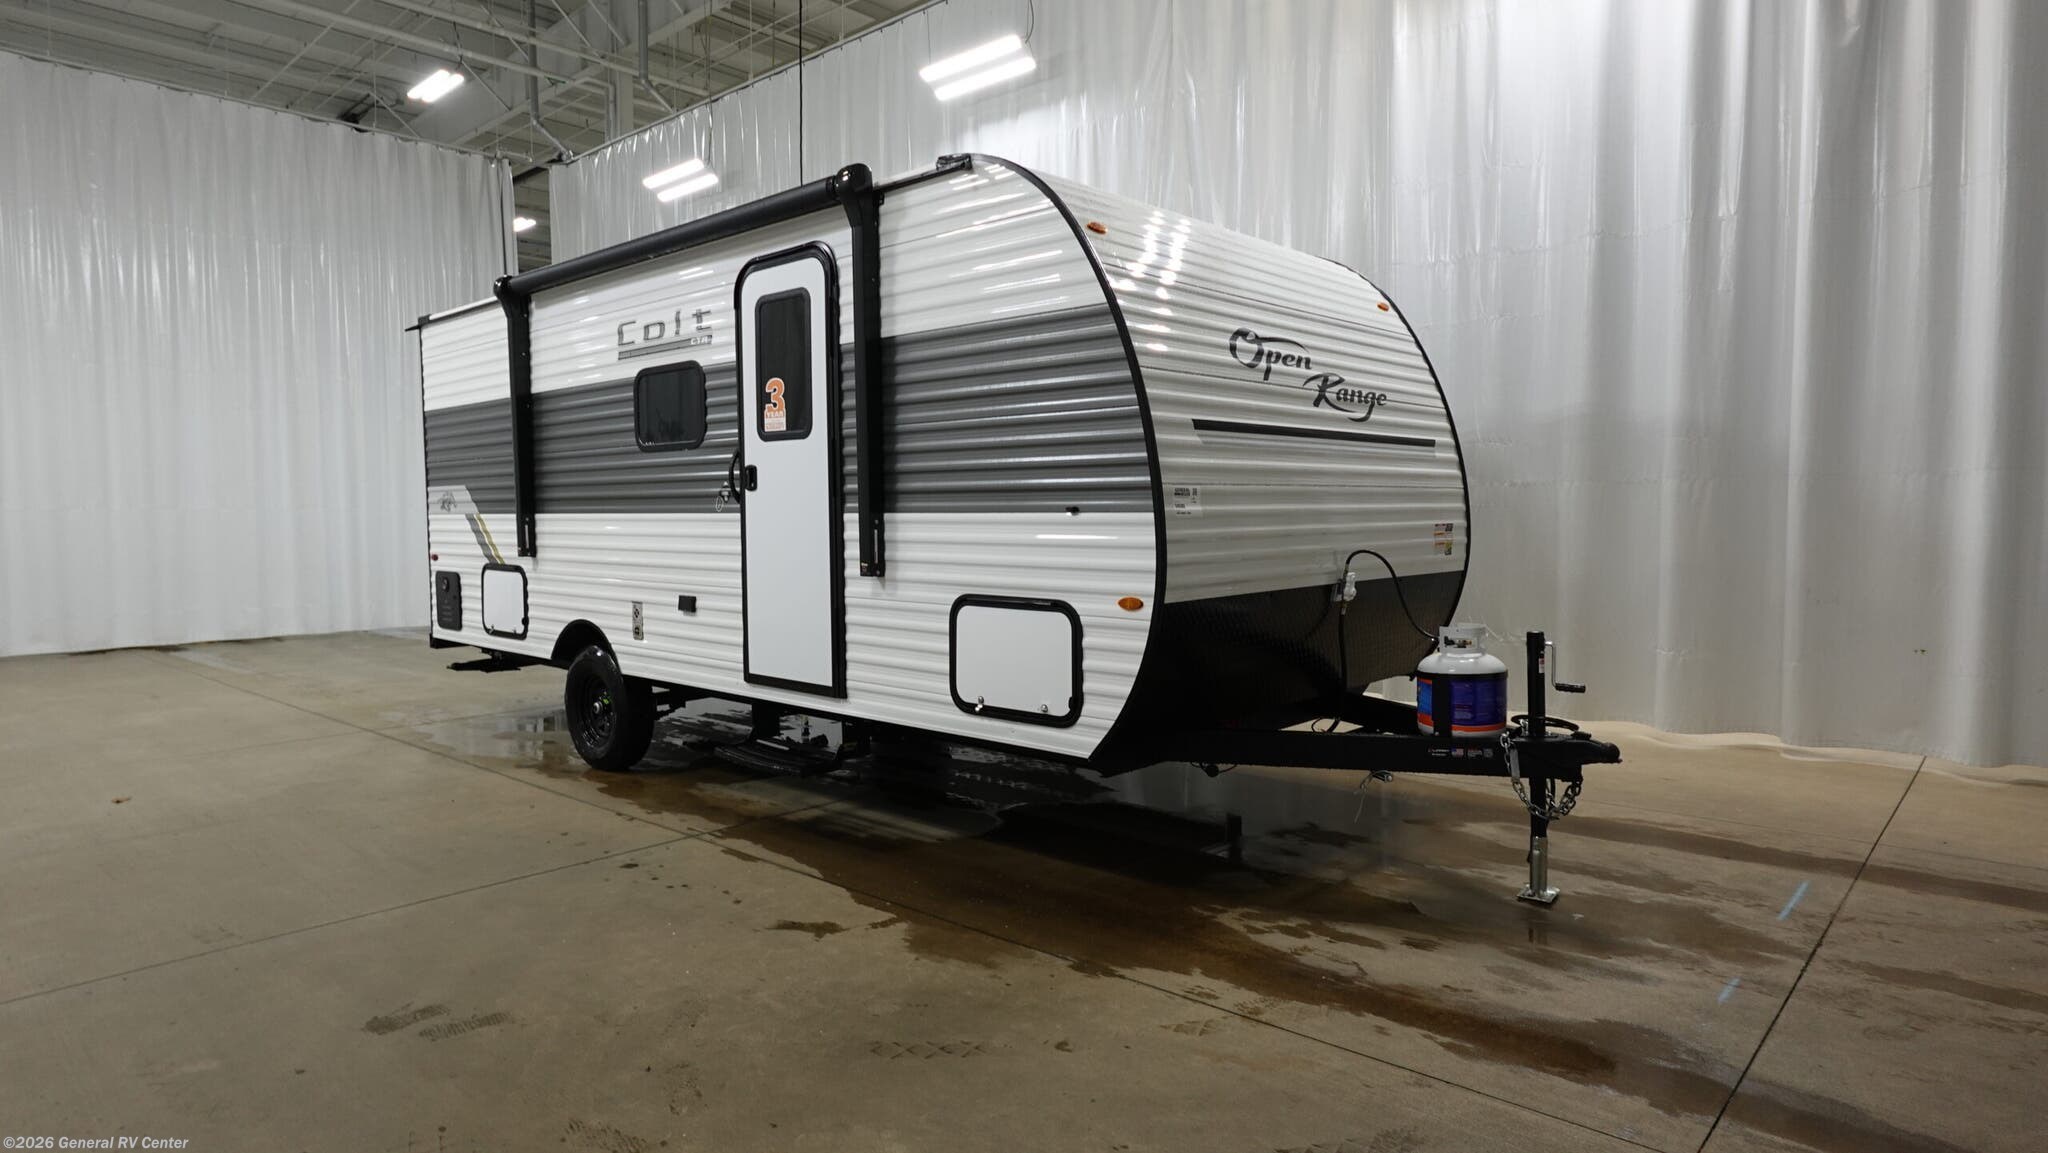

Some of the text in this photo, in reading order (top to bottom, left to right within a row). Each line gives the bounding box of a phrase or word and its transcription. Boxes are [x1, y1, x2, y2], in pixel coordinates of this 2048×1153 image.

[617, 308, 712, 346] Colt
[1229, 327, 1312, 381] Open
[765, 377, 785, 412] 3
[1303, 372, 1387, 422] Range
